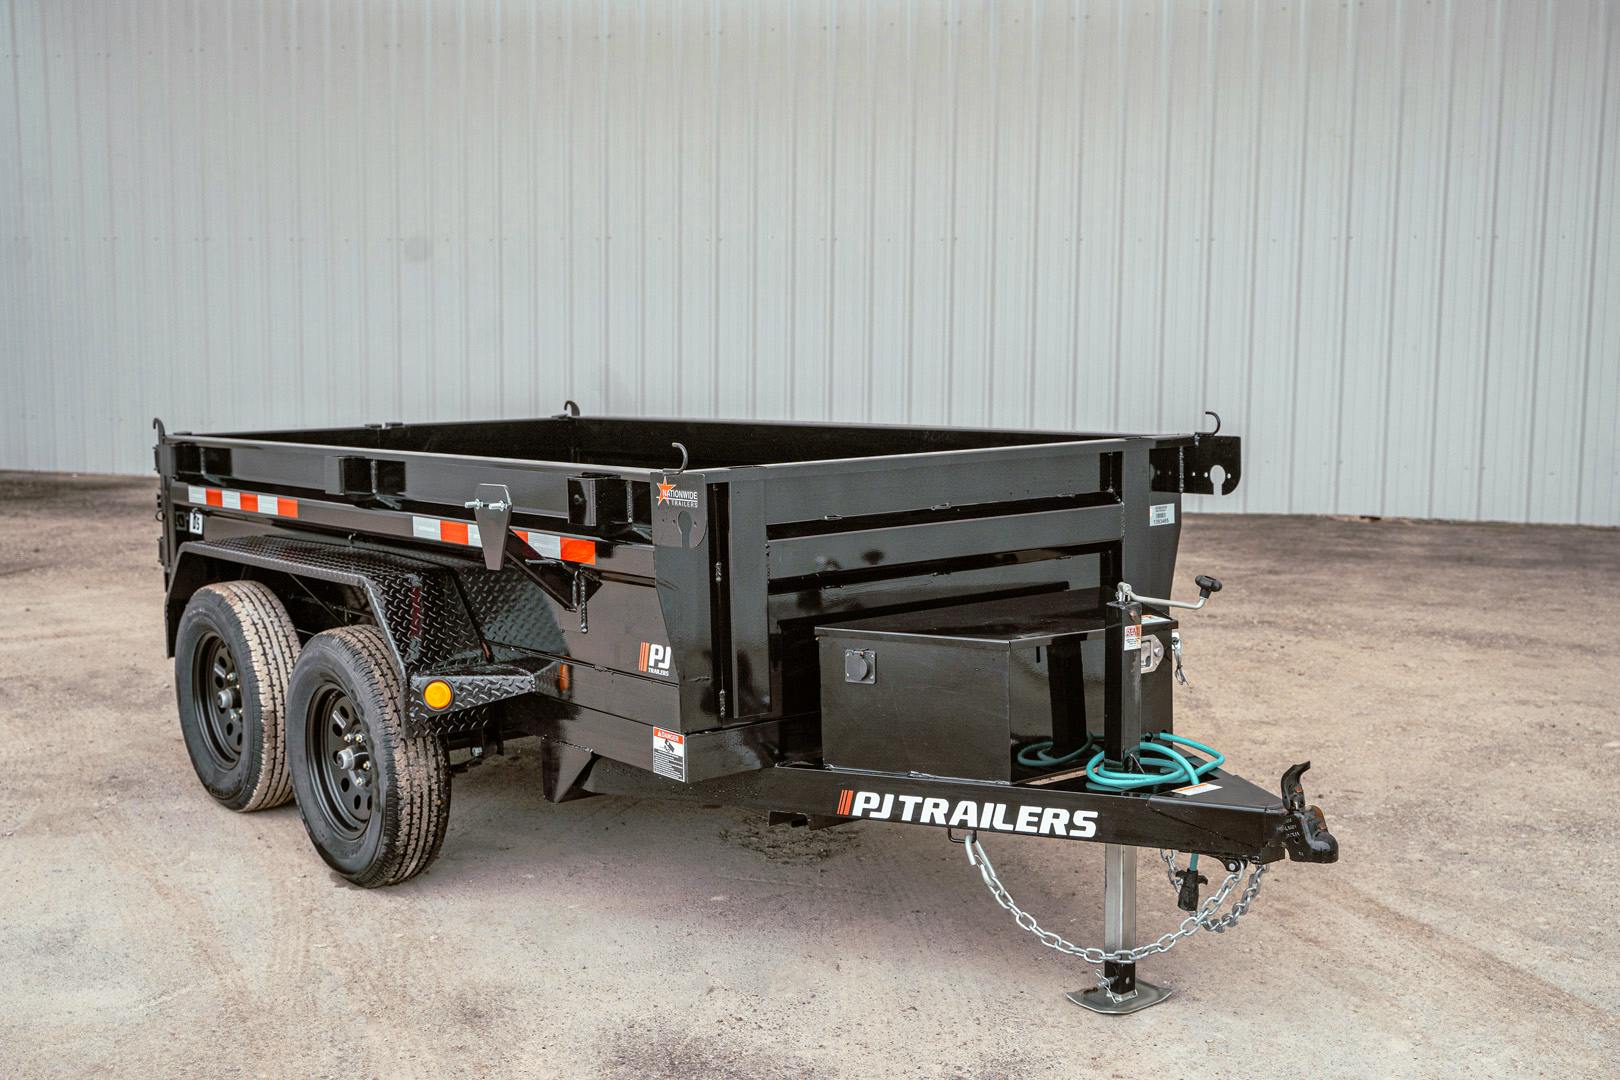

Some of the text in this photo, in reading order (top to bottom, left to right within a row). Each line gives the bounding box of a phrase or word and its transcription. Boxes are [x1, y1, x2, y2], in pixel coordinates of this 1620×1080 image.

[663, 489, 698, 500] NATIONWIDE
[671, 500, 698, 508] TRAILERS
[649, 643, 672, 669] PJ
[648, 668, 669, 677] TRAILERS
[851, 791, 1099, 838] PJ TRAILERS
